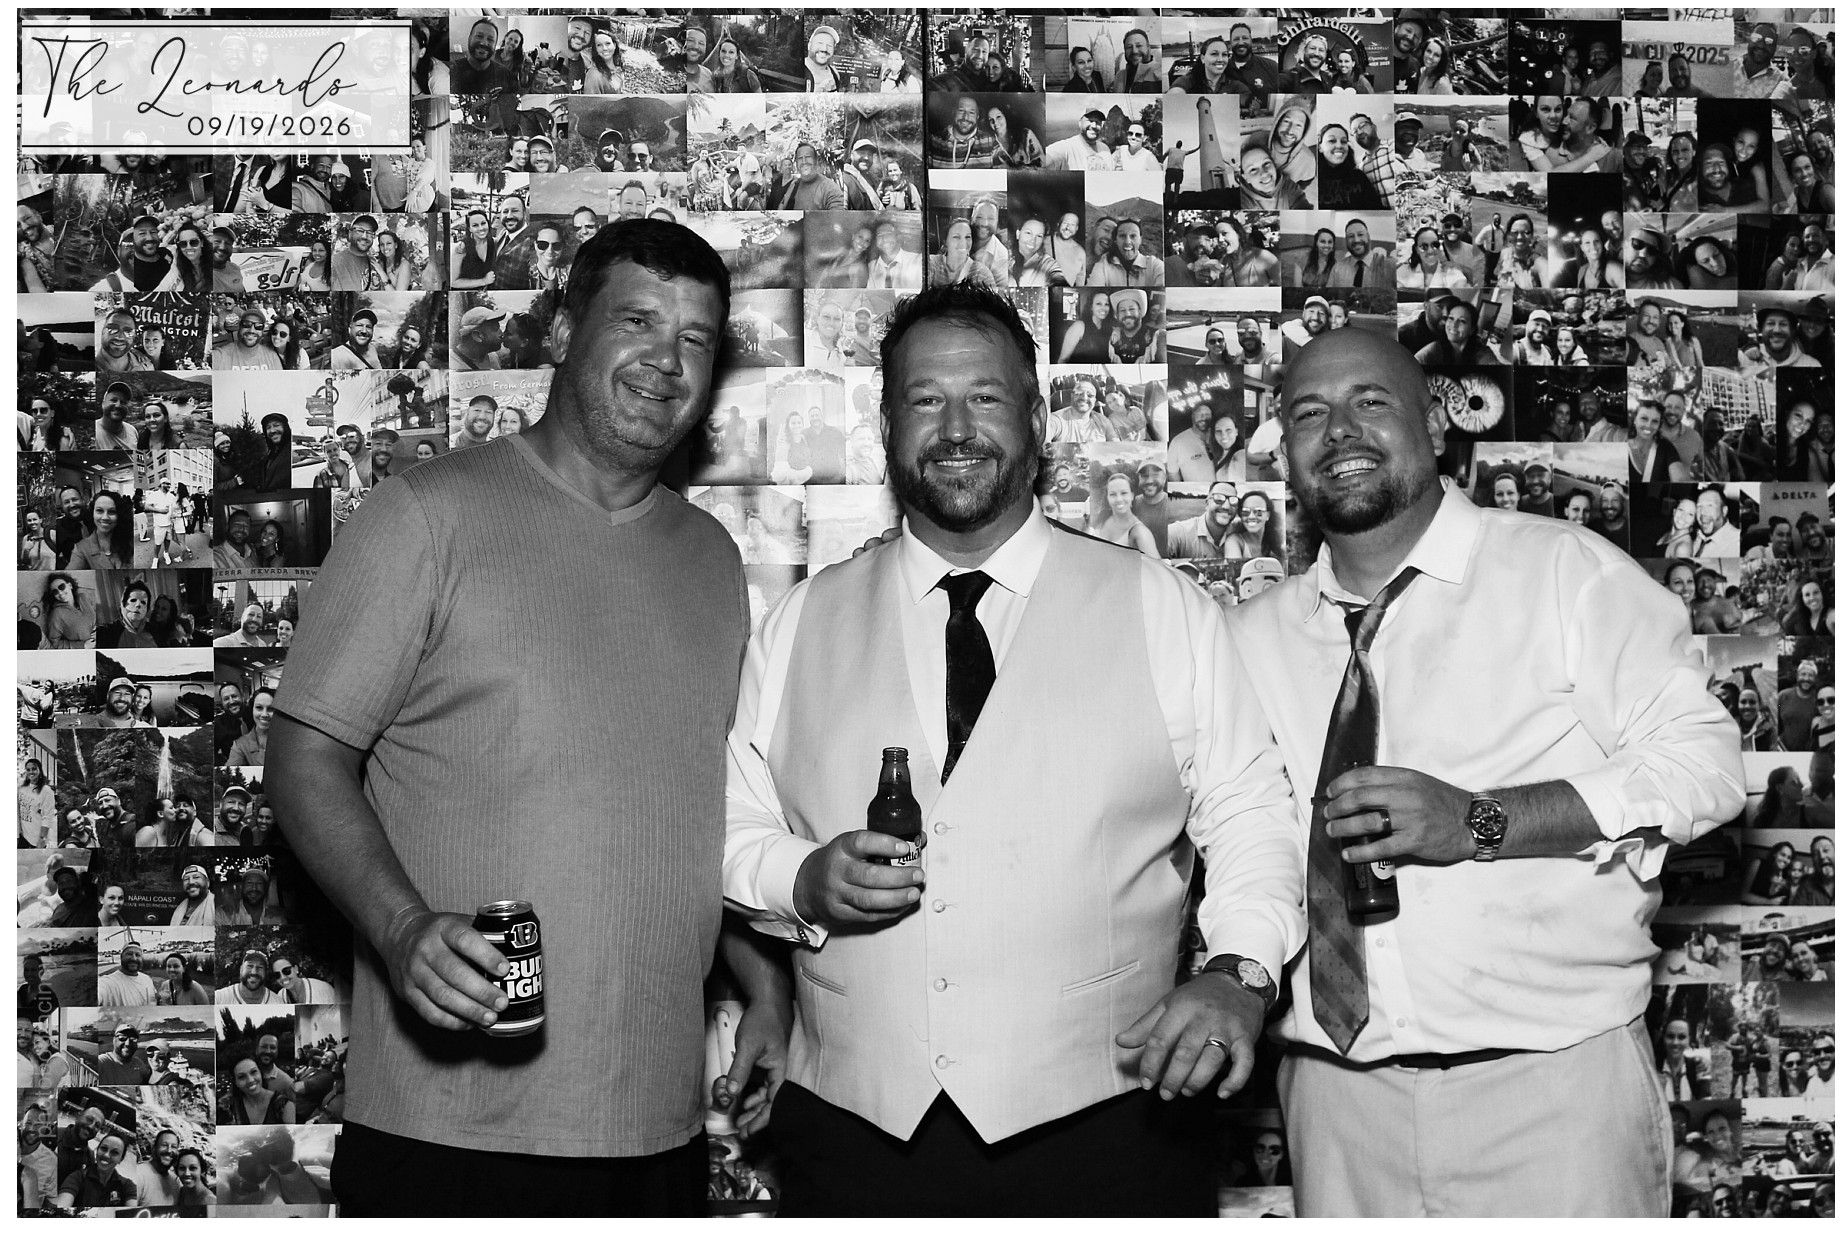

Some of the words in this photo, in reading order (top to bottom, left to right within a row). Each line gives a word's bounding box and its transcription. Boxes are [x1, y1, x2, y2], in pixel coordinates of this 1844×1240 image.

[1277, 16, 1364, 46] Ghirardelli
[1687, 46, 1730, 65] 2025
[257, 258, 298, 290] golf
[138, 324, 198, 337] CNGTON
[493, 380, 516, 390] From
[1781, 491, 1817, 500] DELTA
[1254, 559, 1265, 571] G
[503, 954, 543, 981] BUD
